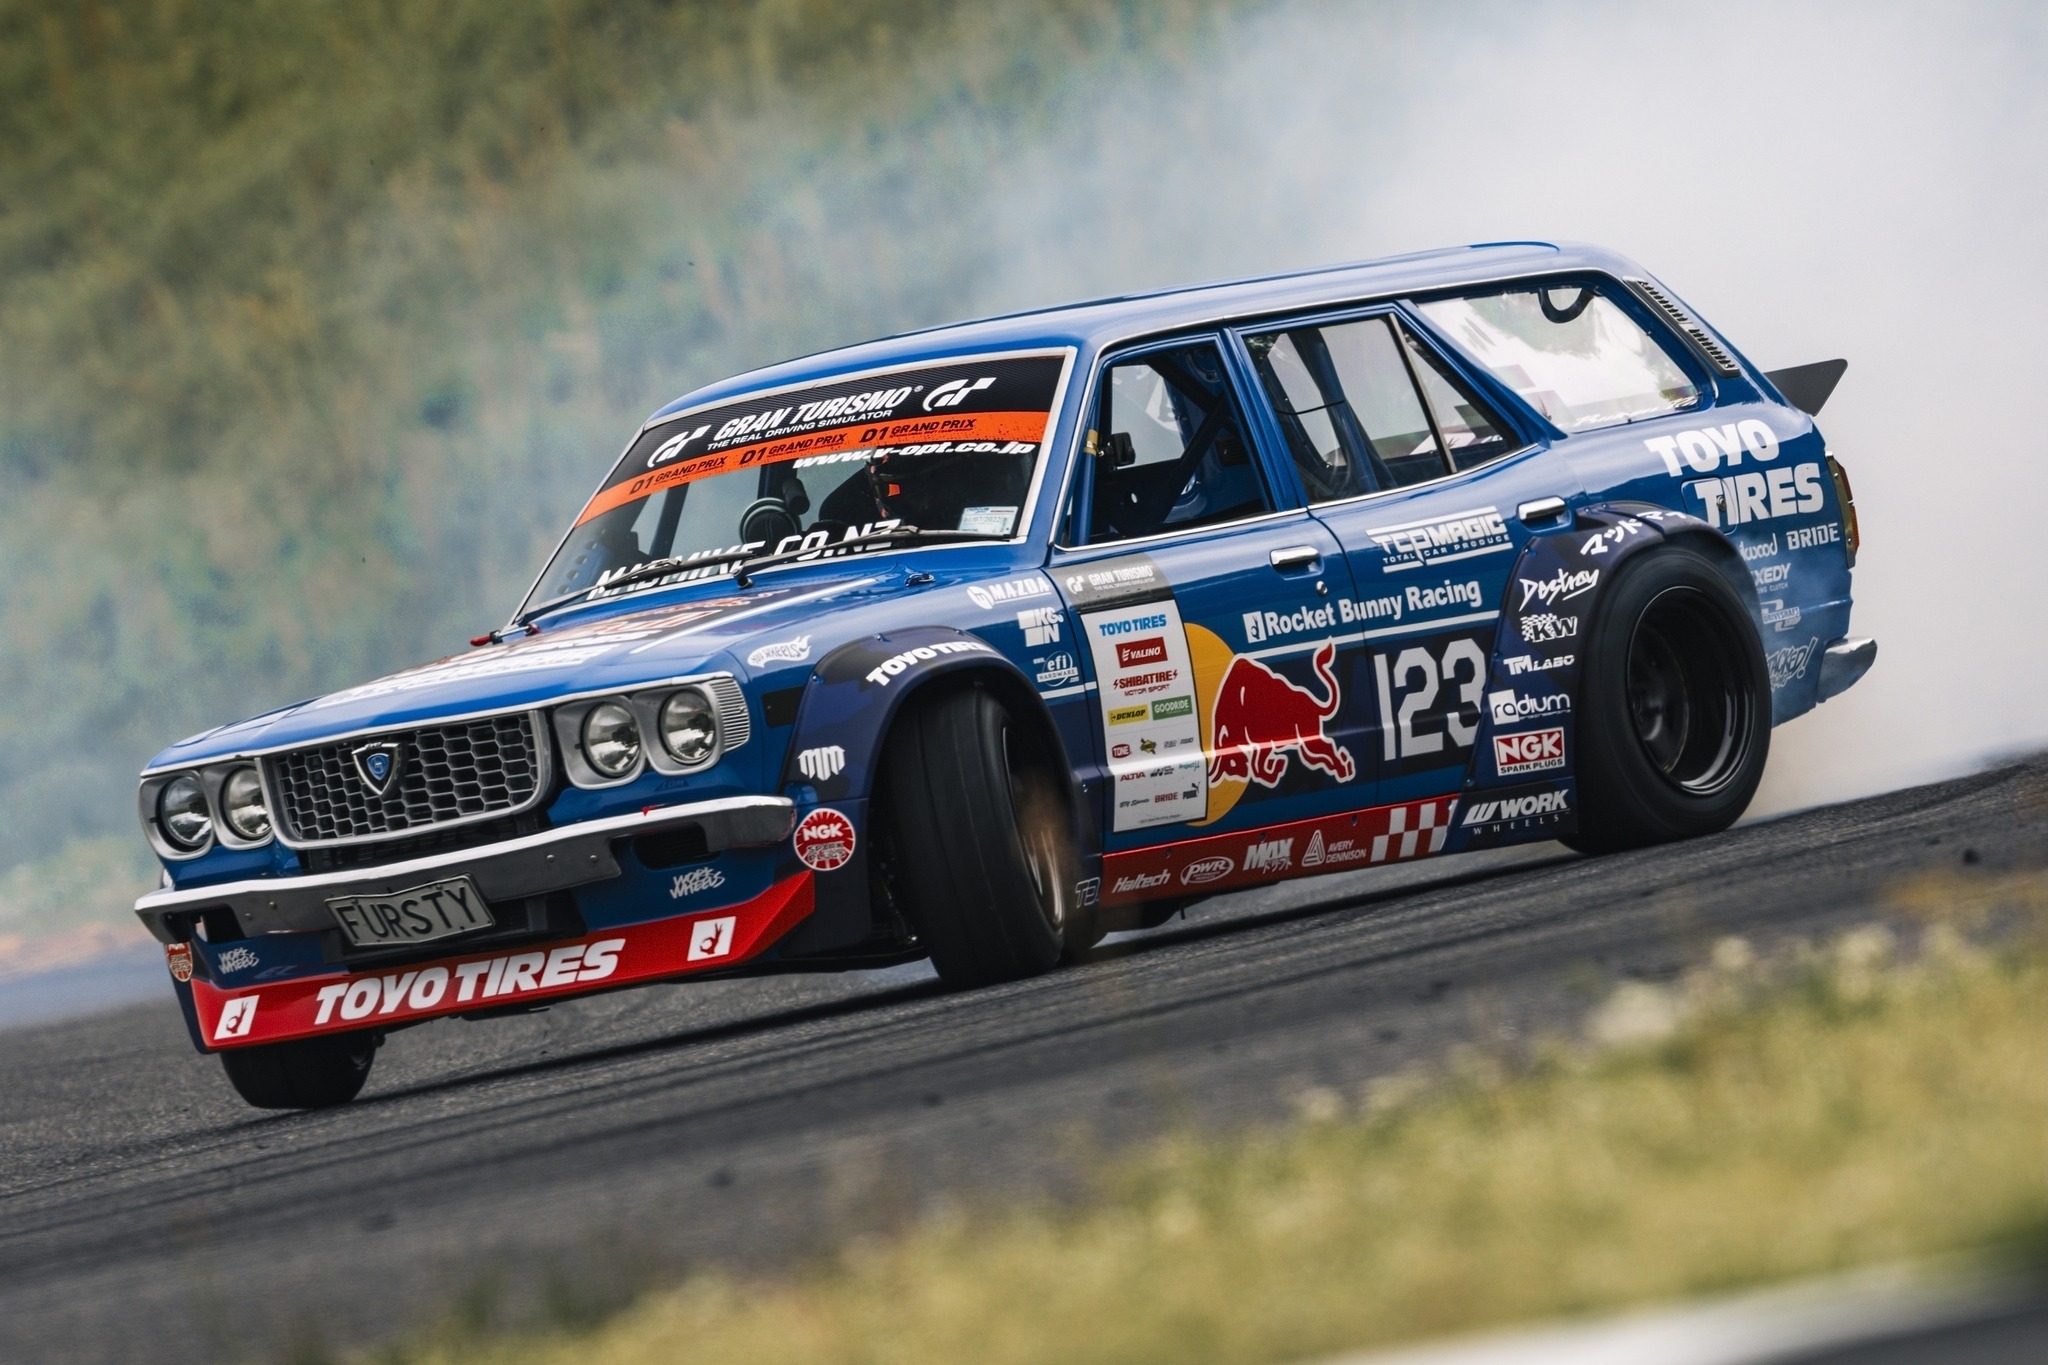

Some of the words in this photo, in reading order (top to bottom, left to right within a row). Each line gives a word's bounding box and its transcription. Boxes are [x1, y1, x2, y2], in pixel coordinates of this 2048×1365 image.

[707, 439, 731, 450] THE
[731, 432, 761, 446] REAL
[765, 421, 815, 438] DRIVING
[817, 409, 893, 428] SIMULATOR
[713, 406, 793, 441] GRAN
[859, 426, 889, 443] D1
[891, 420, 939, 435] GRAND
[941, 418, 977, 431] PRIX
[739, 446, 767, 465] D1
[768, 438, 814, 454] GRAND
[814, 433, 848, 446] PRIX
[792, 441, 1036, 469] www.v-opt.co.jp
[1644, 419, 1779, 477] TOYO
[629, 475, 655, 495] D1
[655, 463, 697, 482] GRAND
[697, 456, 728, 471] PRIX
[1694, 463, 1824, 530] TIRES
[1383, 552, 1415, 564] TOTAL
[1424, 547, 1448, 558] CAR
[1454, 533, 1511, 551] PRODUCE
[1786, 522, 1840, 551] BRIDE
[989, 577, 1050, 600] MAZDA
[1088, 571, 1115, 586] GRAN
[1264, 602, 1336, 636] Rocket
[1338, 594, 1402, 625] Bunny
[1405, 579, 1482, 611] Racing
[1099, 620, 1131, 636] TOYO
[1134, 614, 1167, 631] TIRES
[1531, 616, 1578, 643] KW
[1047, 655, 1067, 671] efi
[1130, 647, 1161, 659] VALINO
[865, 647, 938, 686] TOYO
[1039, 669, 1076, 680] HARDWARE
[1119, 670, 1173, 689] SHIBATIRE
[1125, 688, 1147, 697] MOTOR
[1149, 684, 1170, 693] SPORT
[1154, 699, 1190, 713] GOODRIDE
[1374, 638, 1487, 761] 123
[1494, 693, 1571, 719] radium
[1116, 709, 1146, 721] DUNLOP
[1497, 732, 1562, 764] NGK
[1501, 763, 1532, 774] SPARK
[1533, 758, 1563, 769] PLUGS
[1154, 791, 1179, 803] BRIDE
[1500, 789, 1569, 820] WORK
[803, 822, 844, 841] NGK
[1473, 814, 1559, 835] WHEELS
[808, 842, 844, 853] SPARK
[808, 851, 846, 862] PLUGS
[1243, 837, 1295, 871] MAX
[1325, 849, 1367, 864] DENNISON
[1327, 839, 1354, 853] AVERY
[1112, 869, 1171, 894] Haltech
[1182, 860, 1228, 885] PWR
[335, 887, 476, 939] FURSTY
[314, 967, 449, 1026] TOYO
[455, 939, 626, 1003] TIRES
